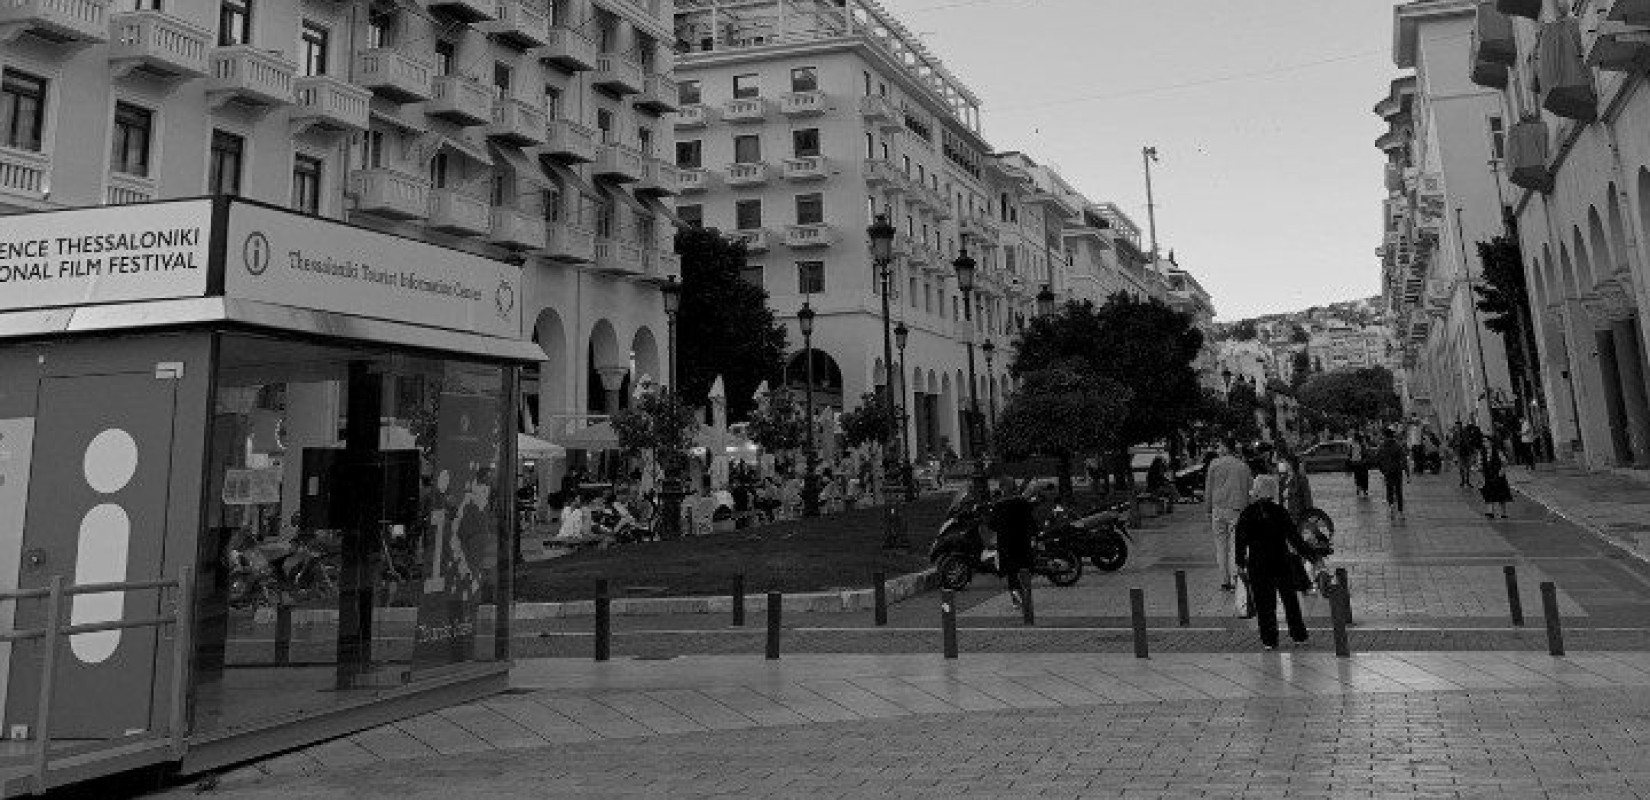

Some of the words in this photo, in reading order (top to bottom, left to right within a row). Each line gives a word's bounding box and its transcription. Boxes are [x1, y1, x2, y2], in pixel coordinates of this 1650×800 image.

[55, 227, 200, 255] THESSALONIKI
[59, 259, 102, 278] FILM
[109, 252, 198, 274] FESTIVAL
[289, 250, 358, 278] Thessaloniki
[362, 263, 397, 286] Tourist
